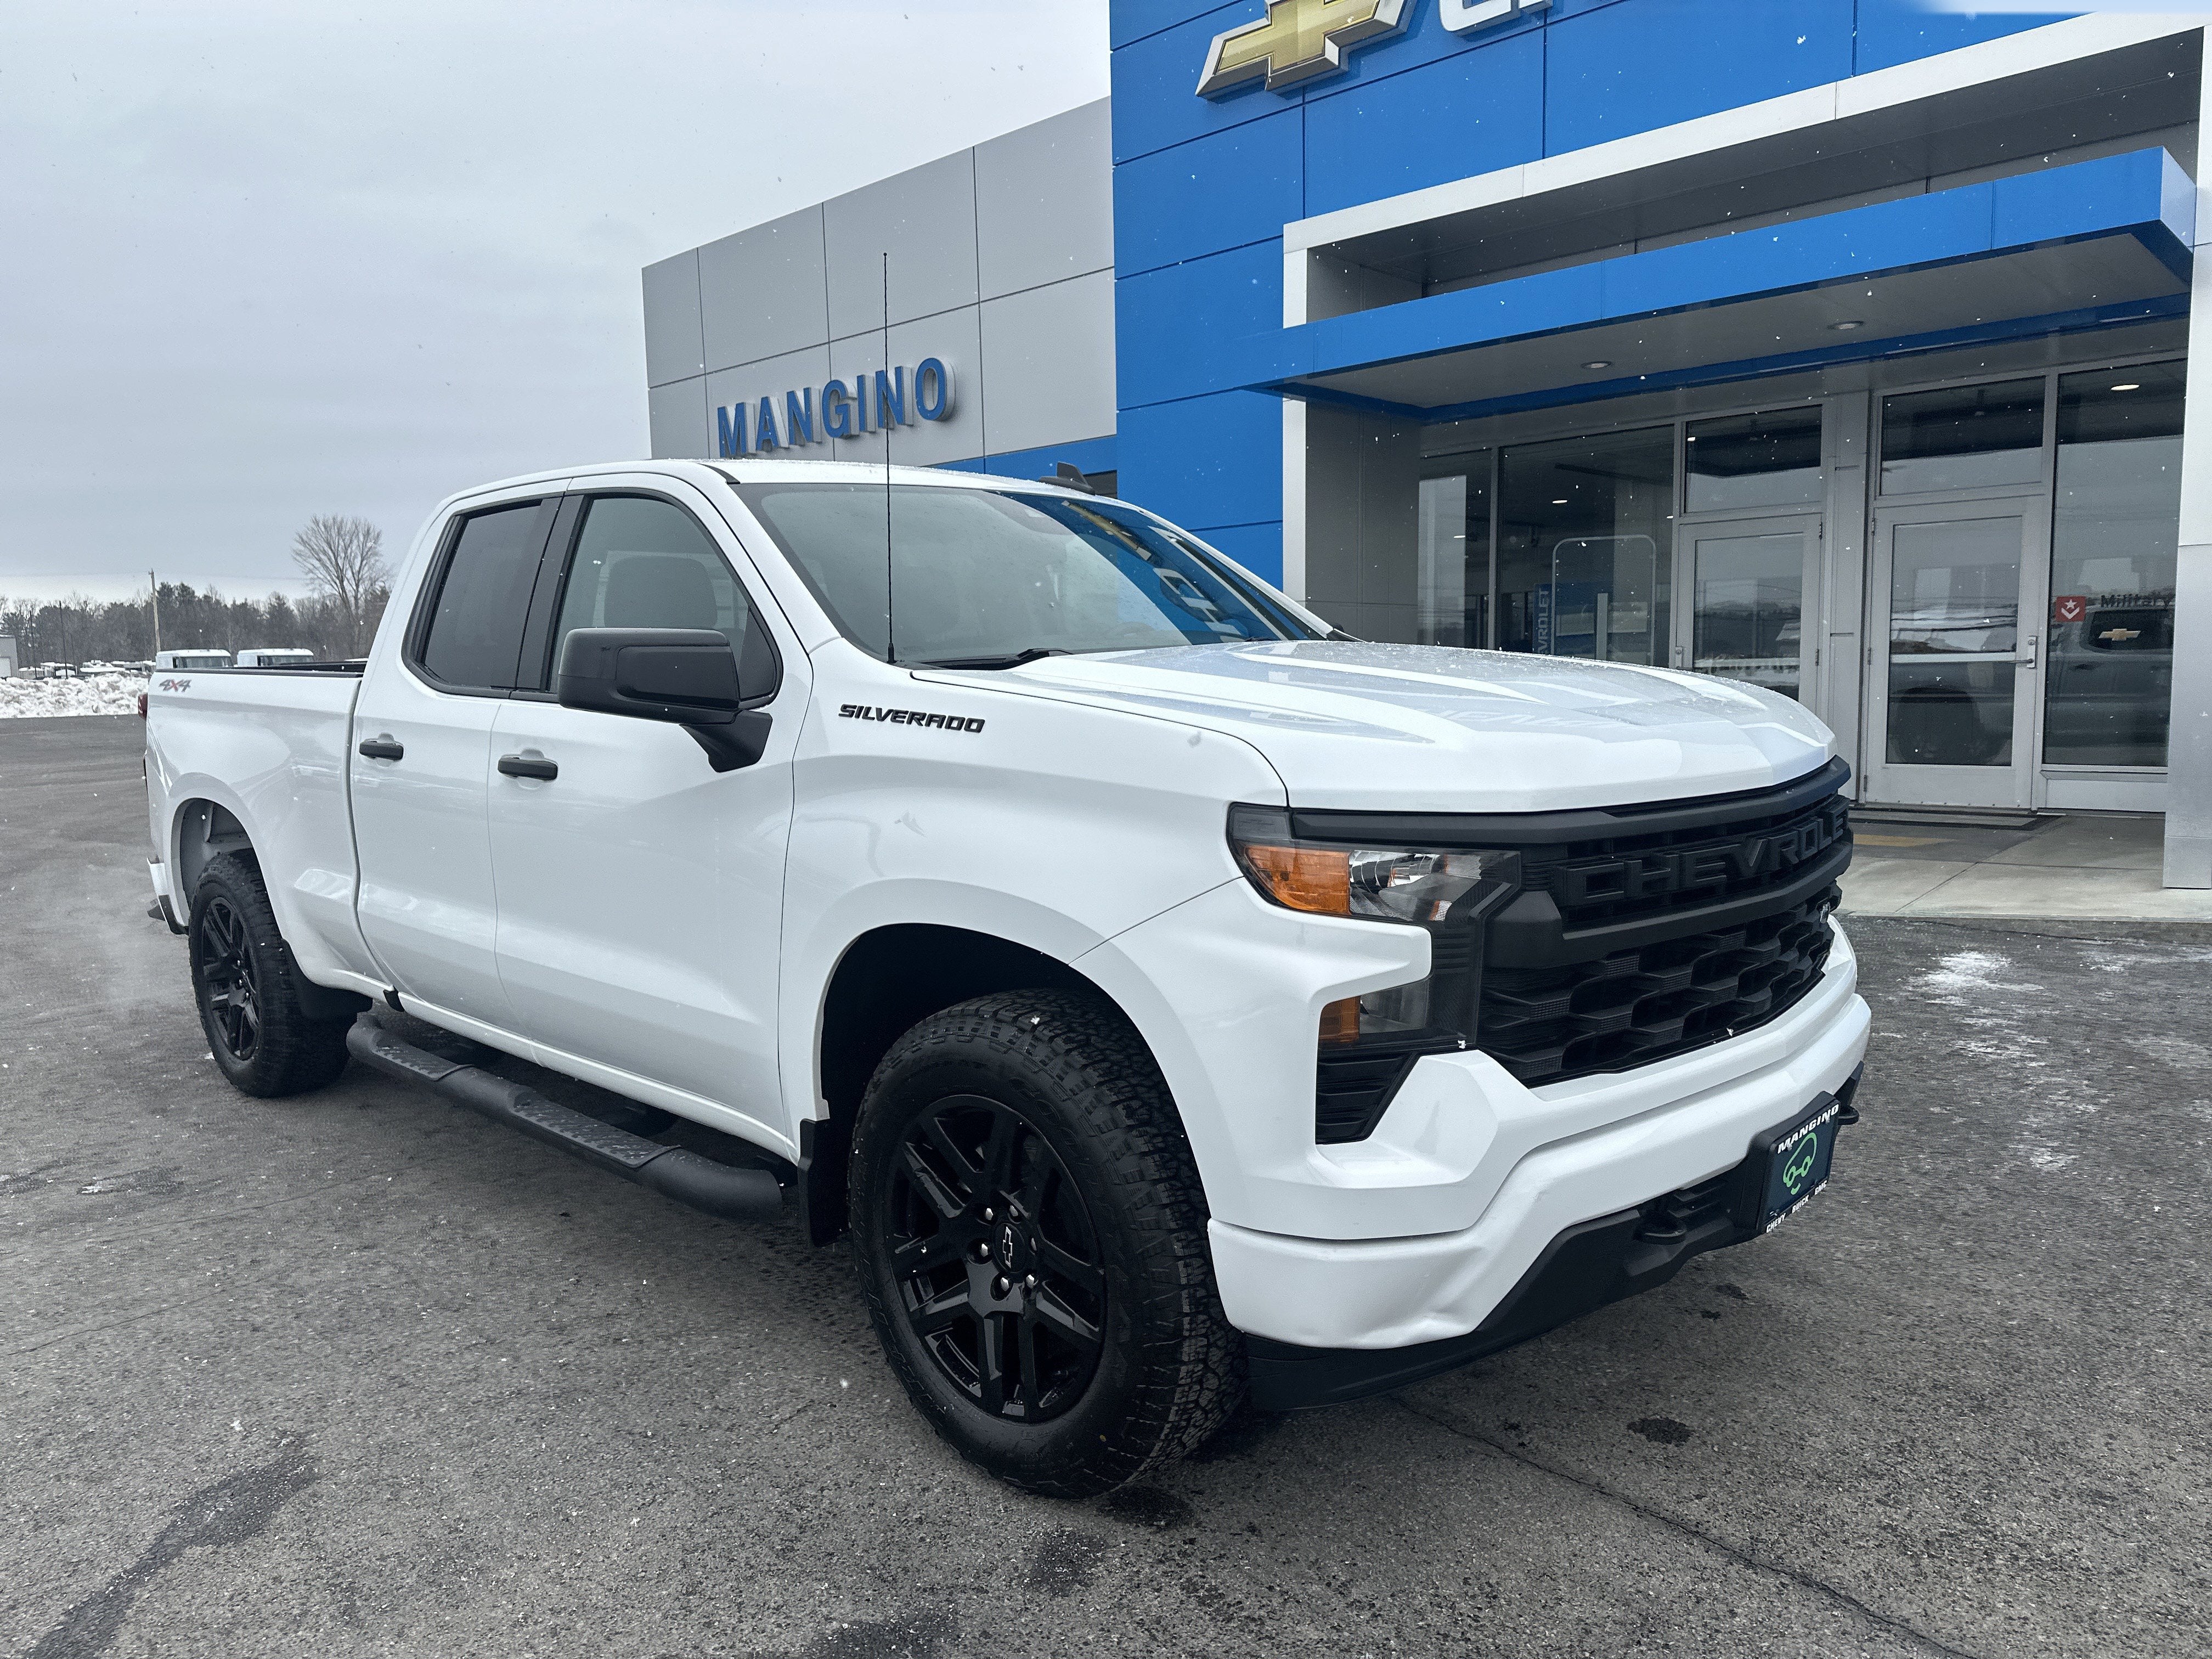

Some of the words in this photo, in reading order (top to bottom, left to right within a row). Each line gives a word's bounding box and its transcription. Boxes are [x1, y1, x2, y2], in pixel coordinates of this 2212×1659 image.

[717, 358, 953, 458] MANGINO
[1538, 587, 1550, 654] VROLET
[838, 703, 985, 733] SILVERADO
[1561, 798, 1849, 906] CHEVROLE
[1777, 1104, 1839, 1154] MANGINO
[1766, 1212, 1786, 1233] CHEVY
[1792, 1195, 1809, 1214] BUICK
[1814, 1180, 1828, 1195] GMC
